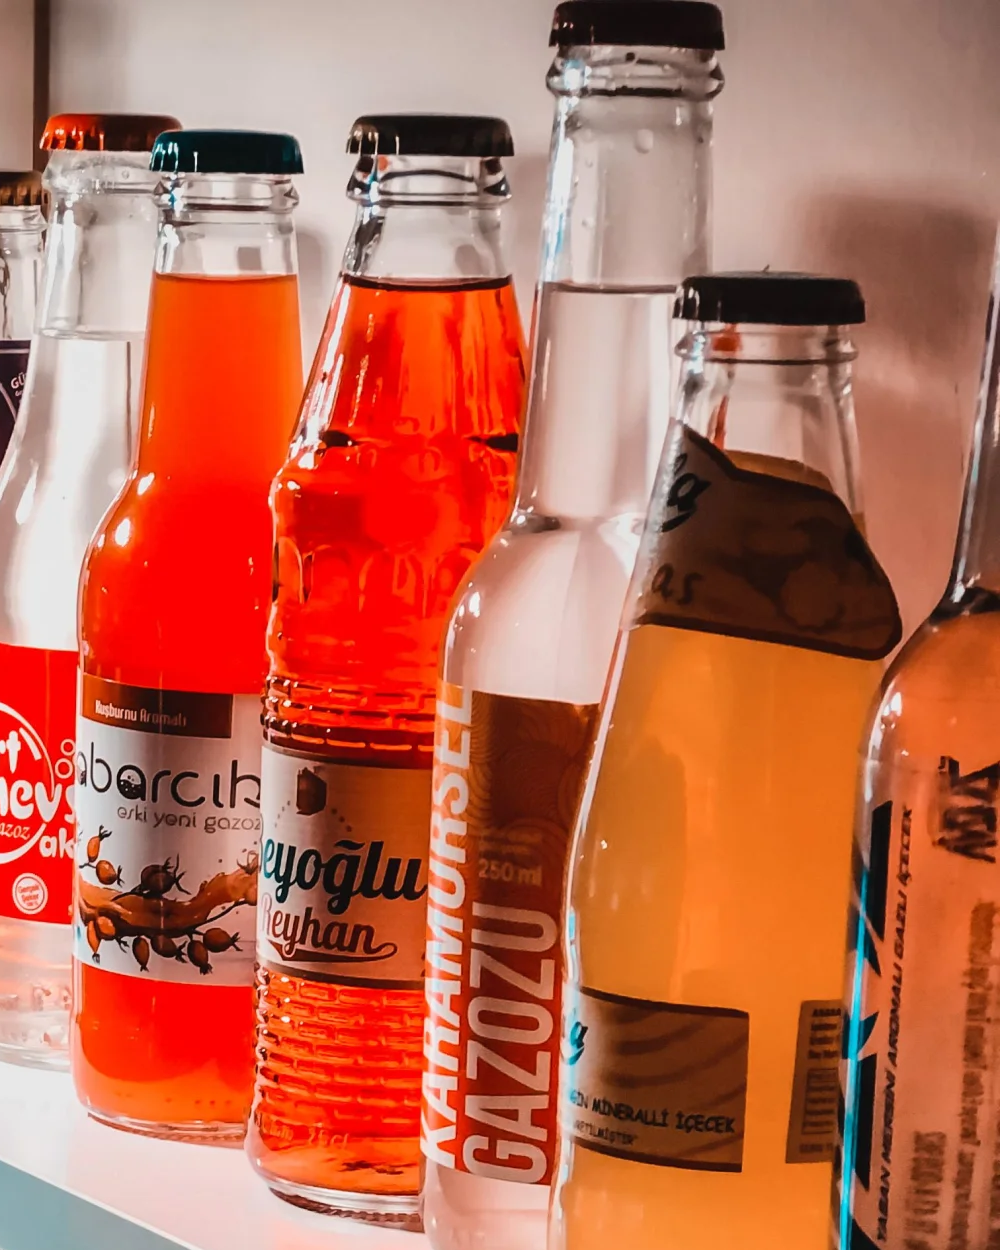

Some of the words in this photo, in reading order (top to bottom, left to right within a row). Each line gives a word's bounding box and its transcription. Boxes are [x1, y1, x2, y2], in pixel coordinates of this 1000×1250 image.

[10, 371, 25, 389] GÜ
[95, 699, 138, 722] Kuşburnu
[117, 804, 148, 823] eski
[153, 811, 197, 829] yeni
[204, 814, 261, 834] gazoz
[262, 838, 428, 915] eyoğlu
[478, 857, 514, 882] 250
[518, 866, 543, 886] ml
[462, 901, 558, 1186] GAZOZU
[592, 1097, 670, 1128] MİNERALLİ
[675, 1109, 736, 1134] İÇECEK
